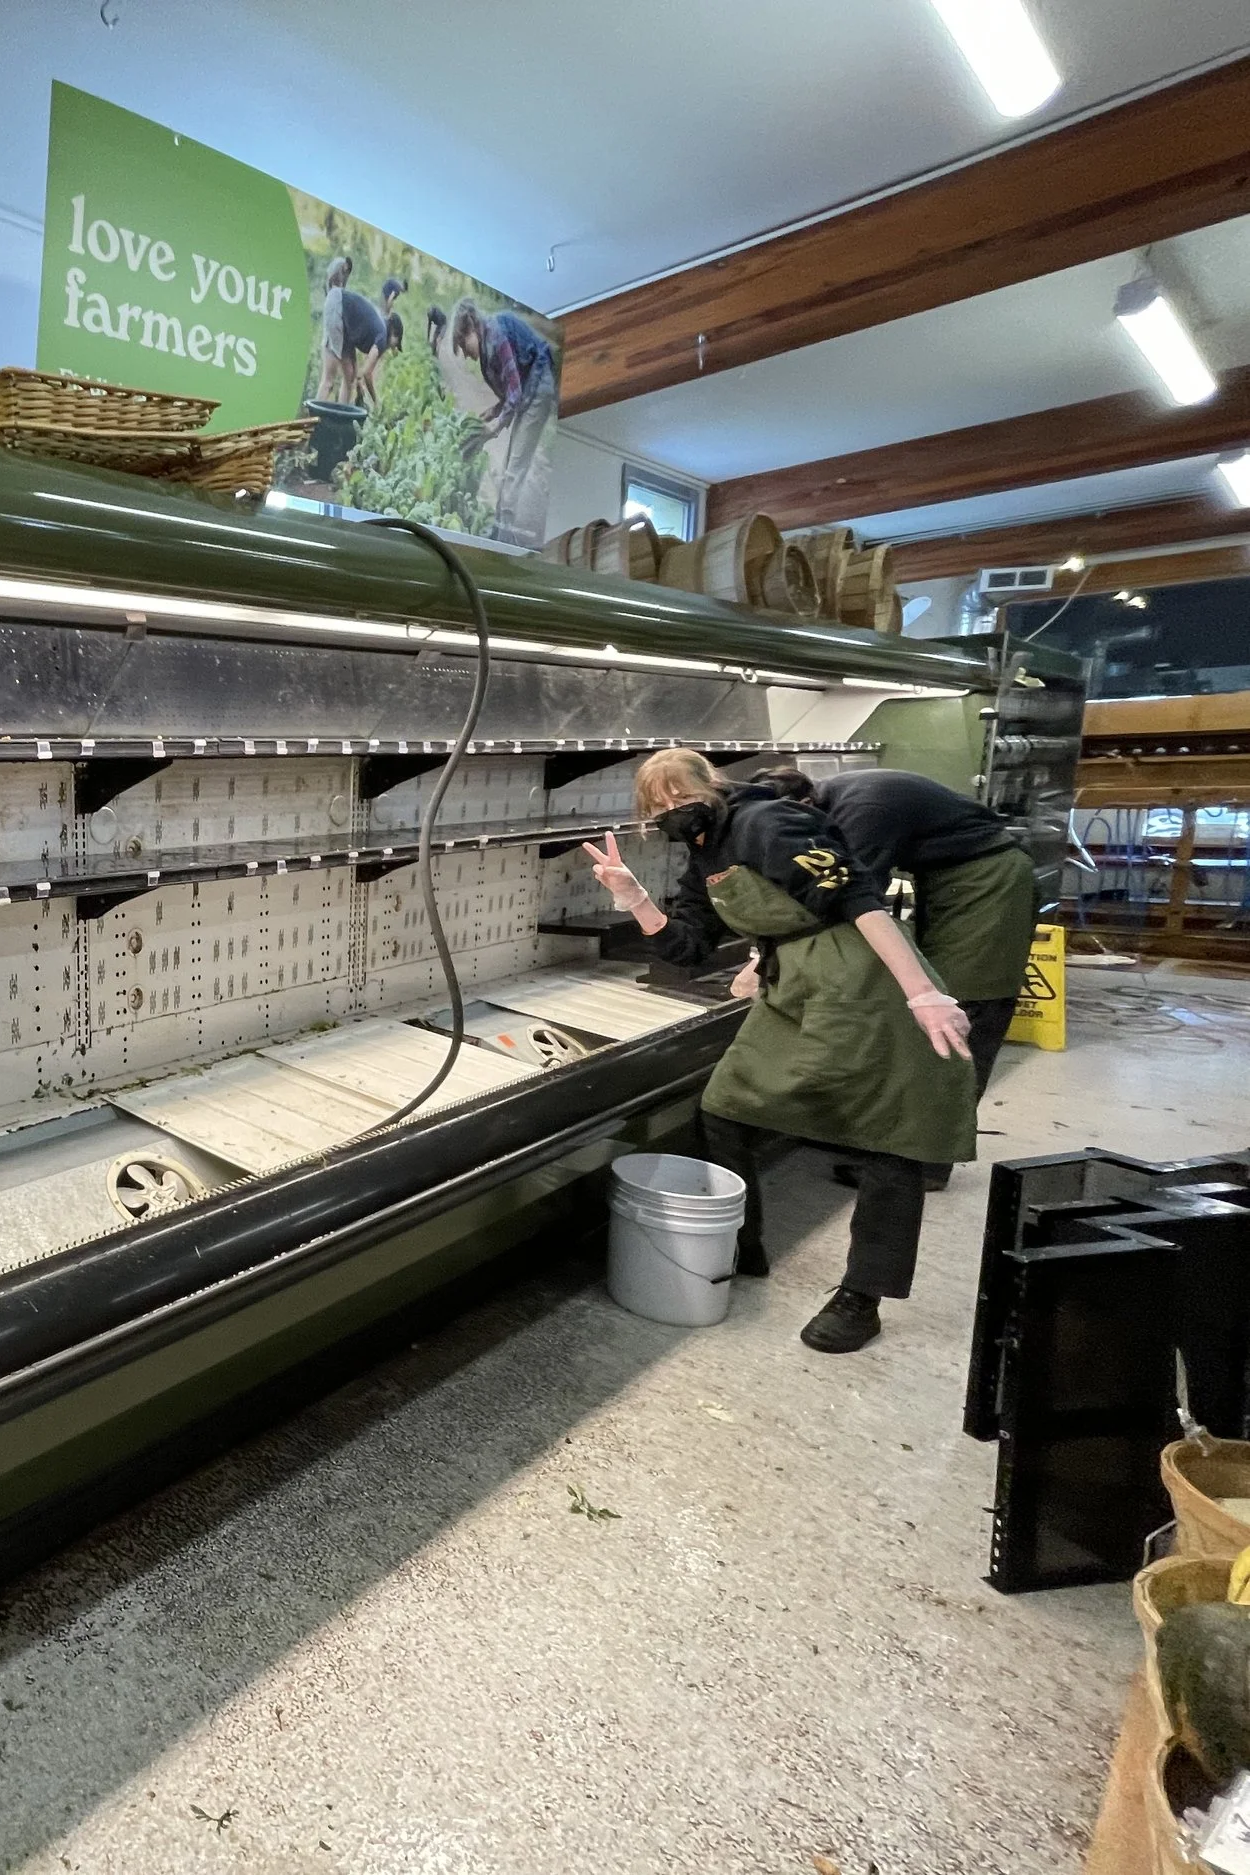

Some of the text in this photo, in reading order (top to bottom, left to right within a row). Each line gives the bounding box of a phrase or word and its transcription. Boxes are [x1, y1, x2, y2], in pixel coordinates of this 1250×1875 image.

[67, 194, 292, 320] love your
[63, 267, 257, 377] farmers
[1029, 953, 1057, 962] TION
